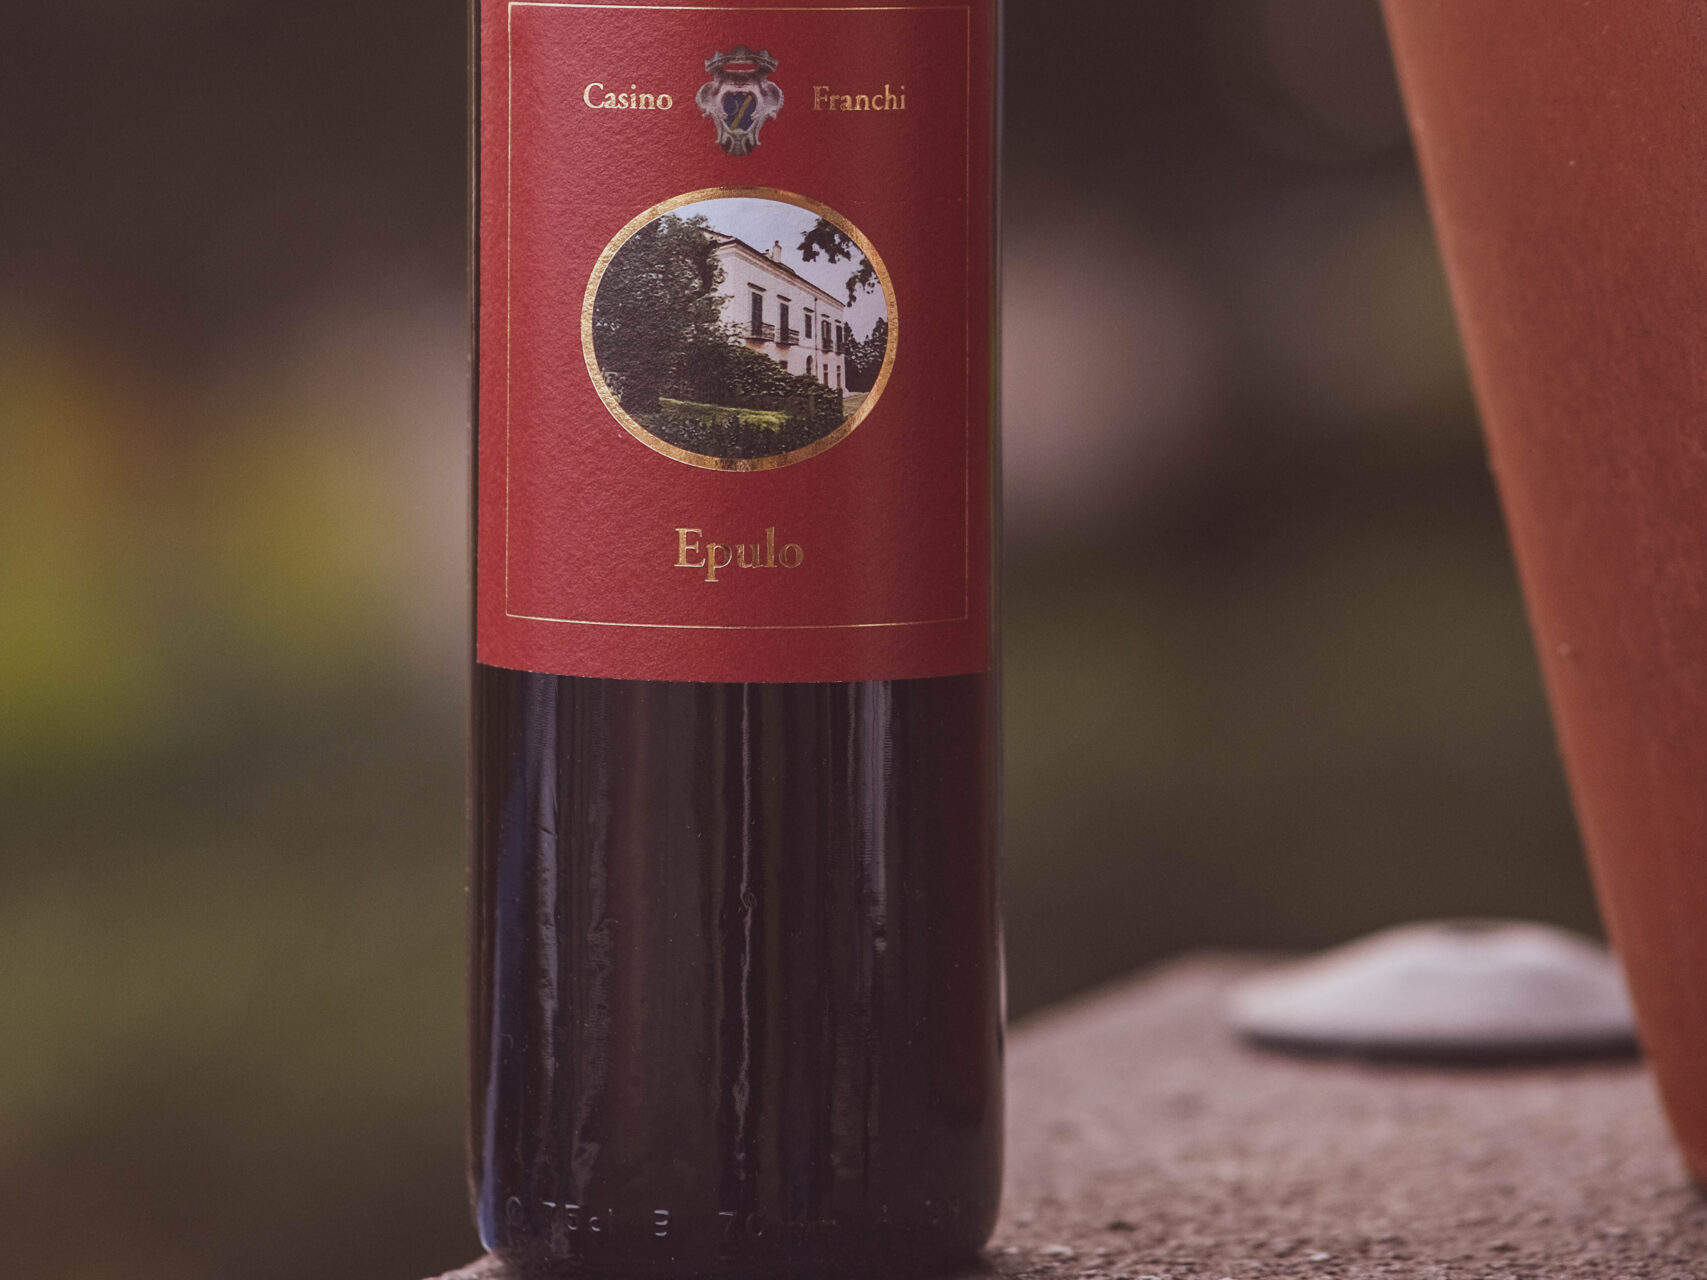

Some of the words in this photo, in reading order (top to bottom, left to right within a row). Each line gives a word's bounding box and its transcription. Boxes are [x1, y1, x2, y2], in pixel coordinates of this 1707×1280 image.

[582, 82, 673, 111] Casino
[812, 84, 907, 112] Franchi
[673, 526, 805, 583] Epulo
